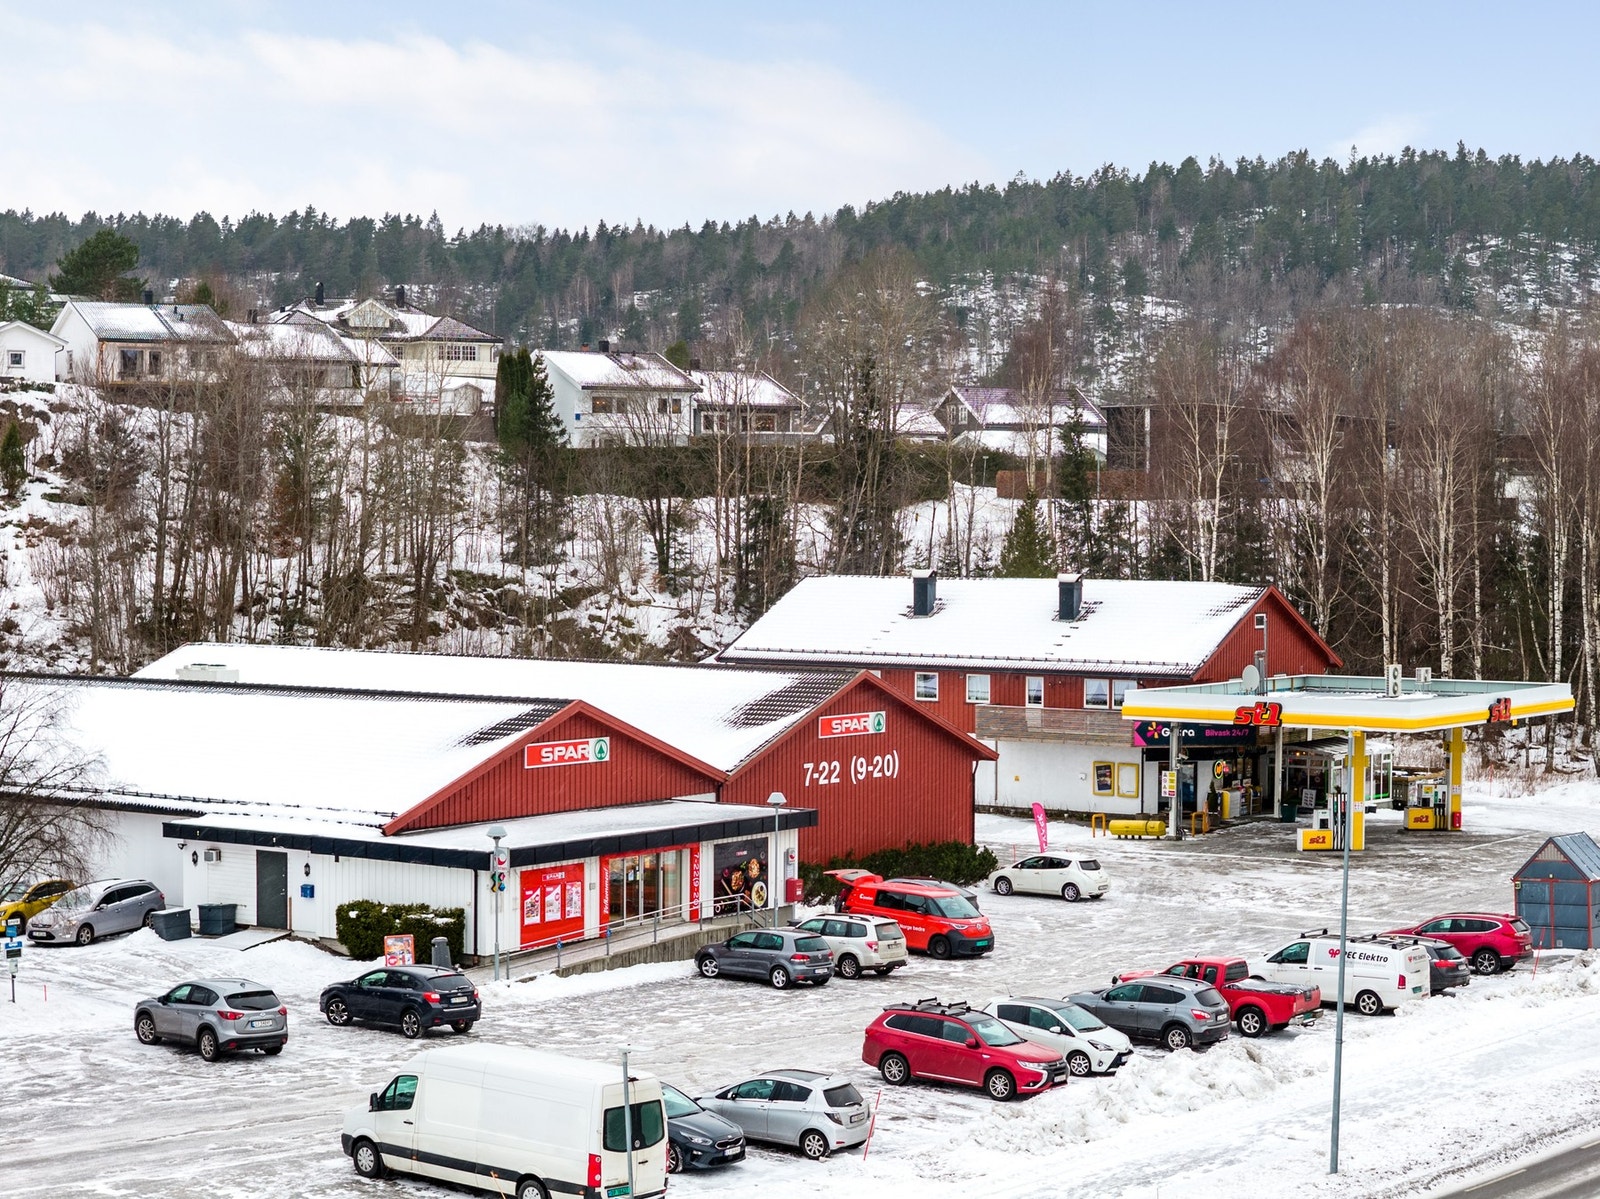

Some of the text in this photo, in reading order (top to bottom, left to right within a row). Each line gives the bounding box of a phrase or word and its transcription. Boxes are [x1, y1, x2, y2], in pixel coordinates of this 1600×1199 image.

[1234, 702, 1282, 726] st1
[1488, 698, 1511, 723] st1
[831, 714, 870, 733] SPAR
[1161, 727, 1195, 737] Gra
[1205, 728, 1249, 737] Bilvask 24/7
[540, 741, 589, 762] SPAR
[803, 750, 899, 787] 7-22 (9-20)
[1413, 815, 1429, 823] st1
[1309, 836, 1326, 844] st1
[1358, 952, 1389, 963] Elektro
